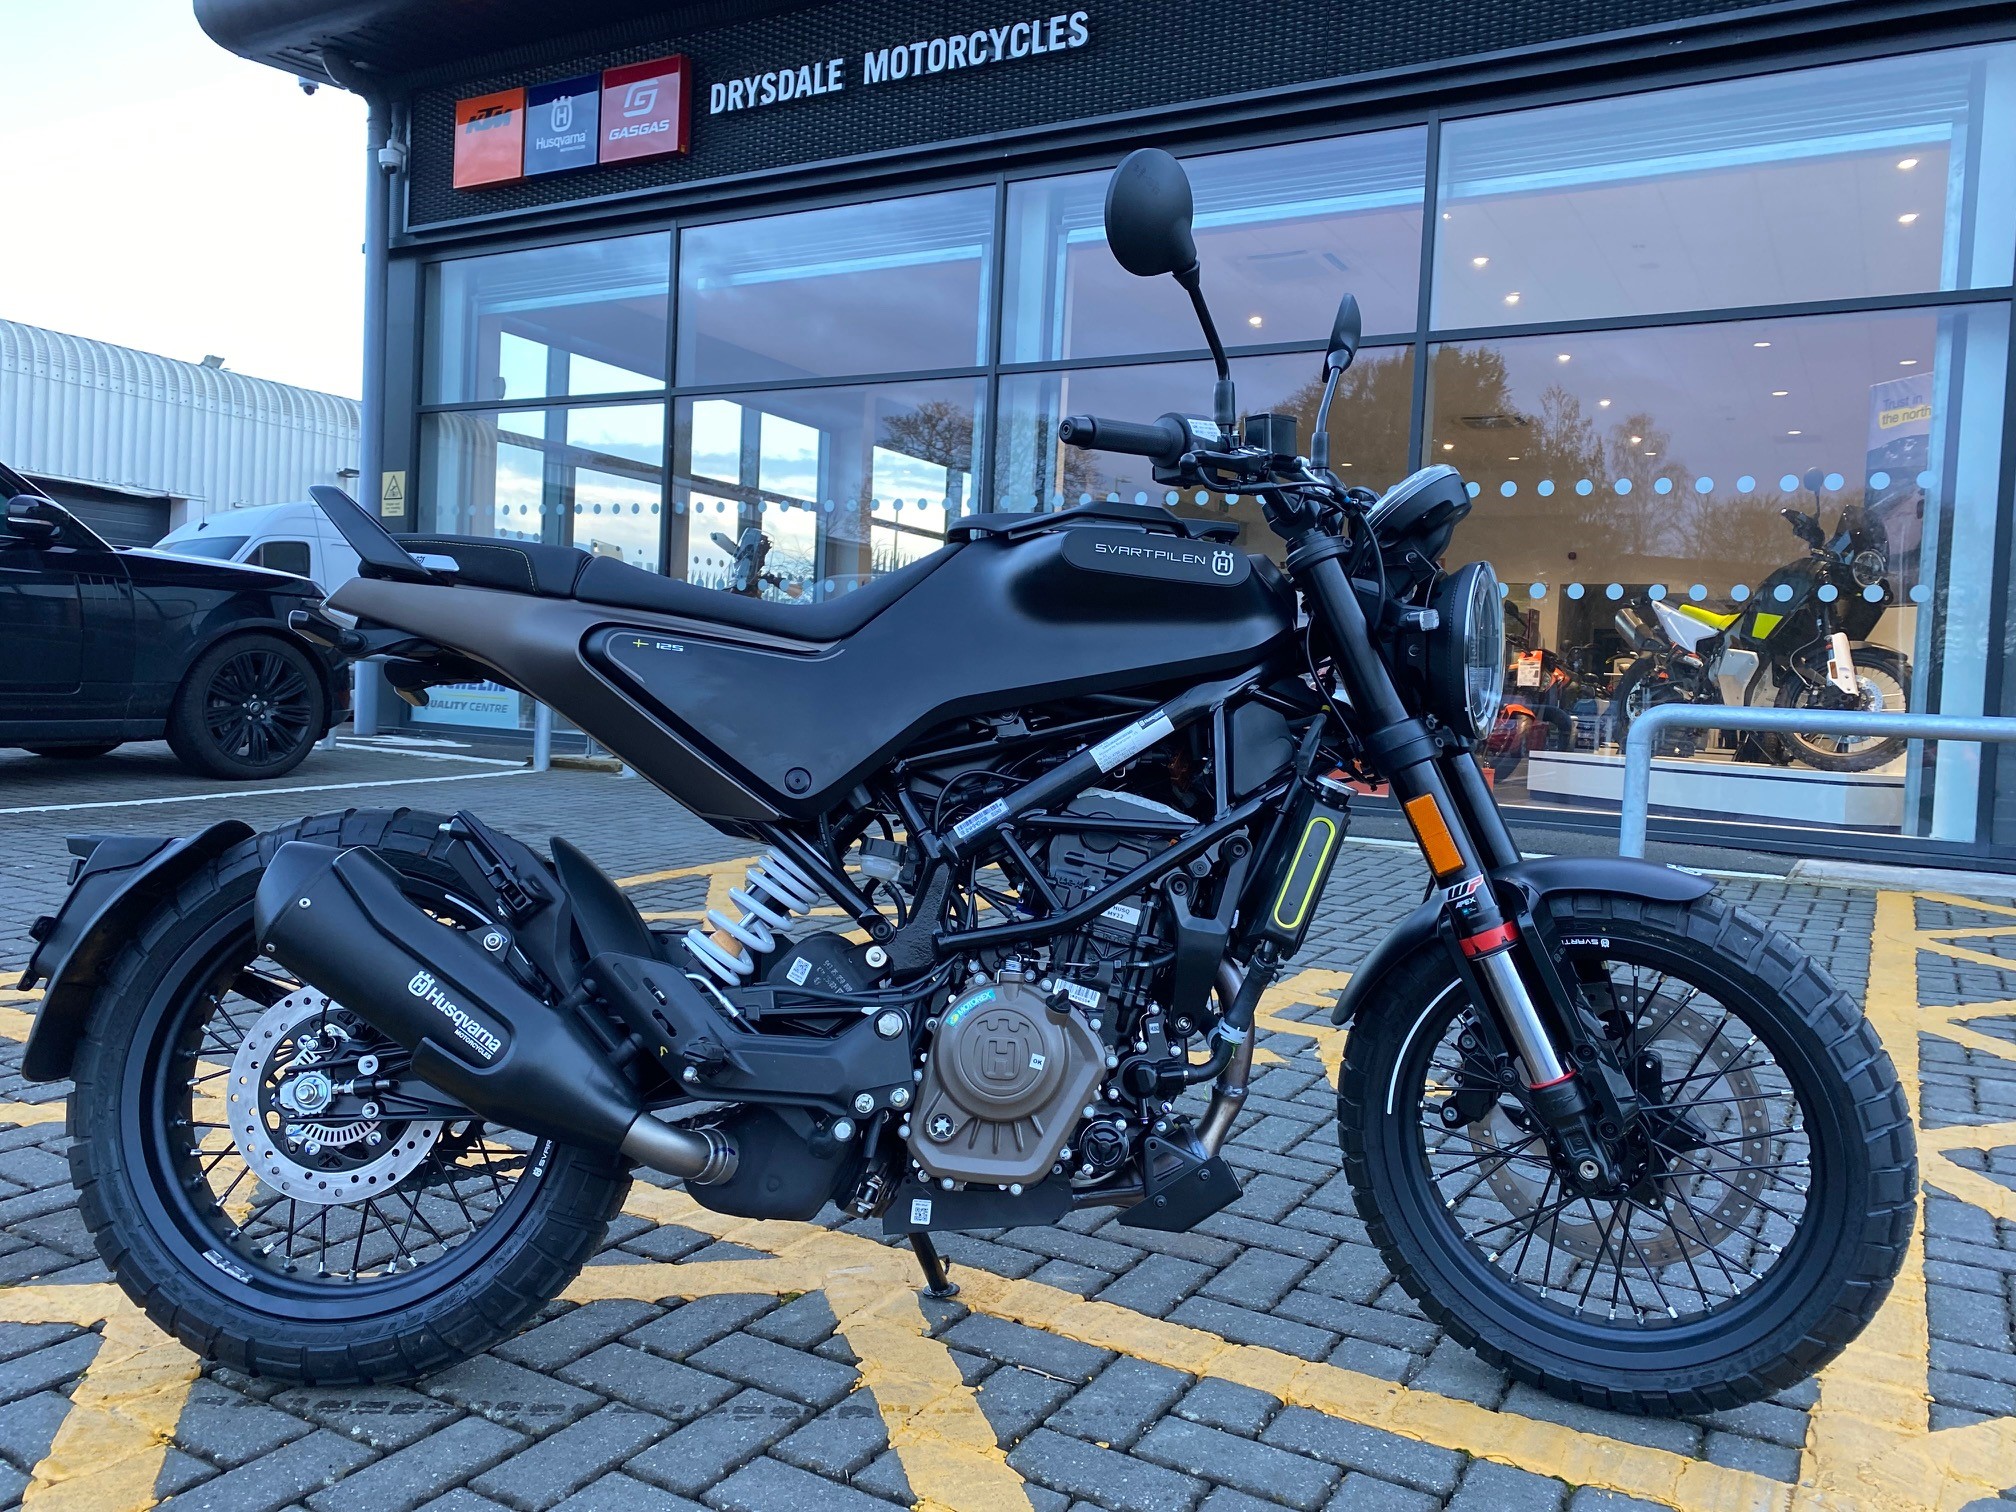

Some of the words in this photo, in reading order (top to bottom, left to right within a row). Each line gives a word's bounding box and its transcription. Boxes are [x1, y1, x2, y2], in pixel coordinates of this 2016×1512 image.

[709, 57, 843, 115] DRYSDALE
[862, 10, 1090, 86] MOTORCYCLES
[465, 104, 513, 135] KTM
[608, 119, 670, 141] GASGAS
[535, 131, 586, 150] Husqvarna
[1883, 396, 1909, 411] Trust
[1912, 394, 1923, 406] in
[1881, 412, 1899, 425] the
[1095, 543, 1206, 565] SVARTPILEN
[655, 642, 684, 652] 125
[469, 701, 508, 714] CENTRE
[957, 990, 993, 1017] MOTOREX
[424, 986, 502, 1053] Husqvarna
[453, 1028, 492, 1061] MOTORCYCLES
